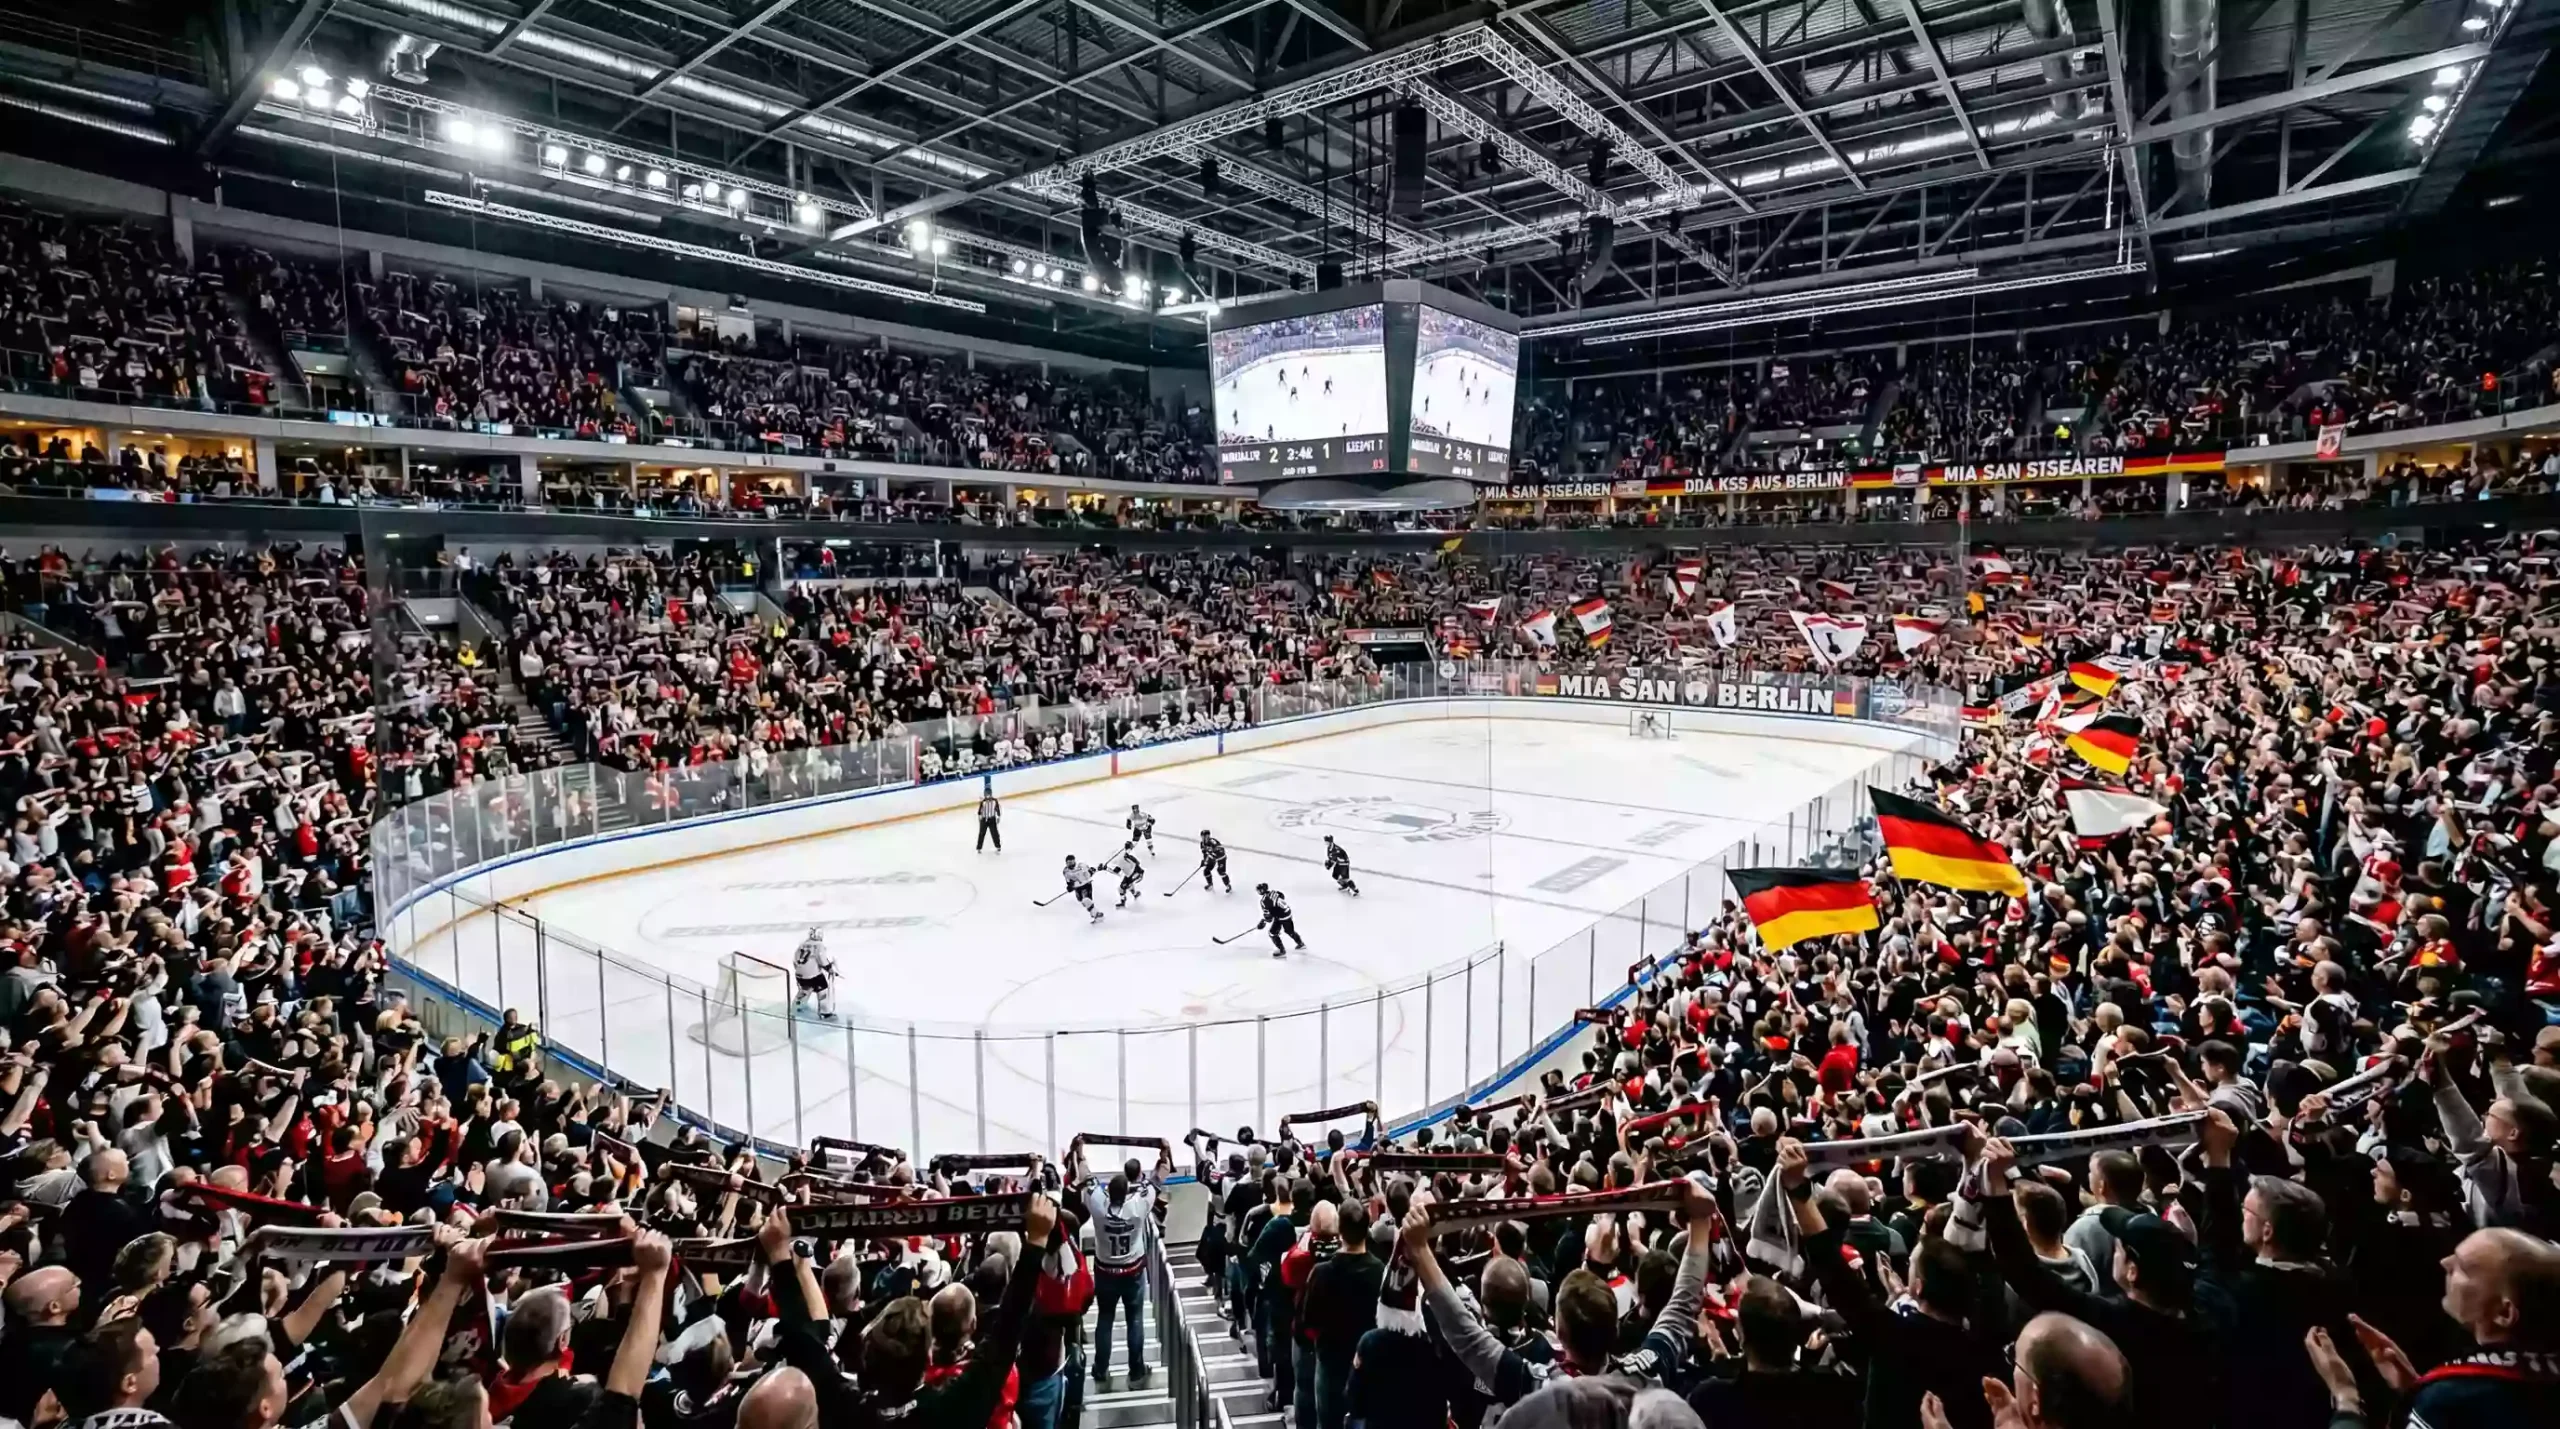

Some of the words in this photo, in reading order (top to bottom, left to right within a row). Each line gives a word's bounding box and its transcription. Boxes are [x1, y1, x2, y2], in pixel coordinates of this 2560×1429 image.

[1269, 448, 1279, 463] 2
[1322, 443, 1330, 459] 1
[1444, 443, 1452, 460] 2
[1718, 476, 1748, 491] KSS
[1752, 475, 1782, 490] AUS
[1786, 472, 1844, 488] BERLIN
[1944, 465, 1977, 482] MIA
[1983, 463, 2020, 480] SAN
[1485, 484, 1508, 499] MIA
[1512, 484, 1538, 498] SAN
[1559, 674, 1611, 698] MIA
[1619, 678, 1676, 702] SAN
[1717, 683, 1834, 714] BERLIN
[1108, 1235, 1130, 1256] 19
